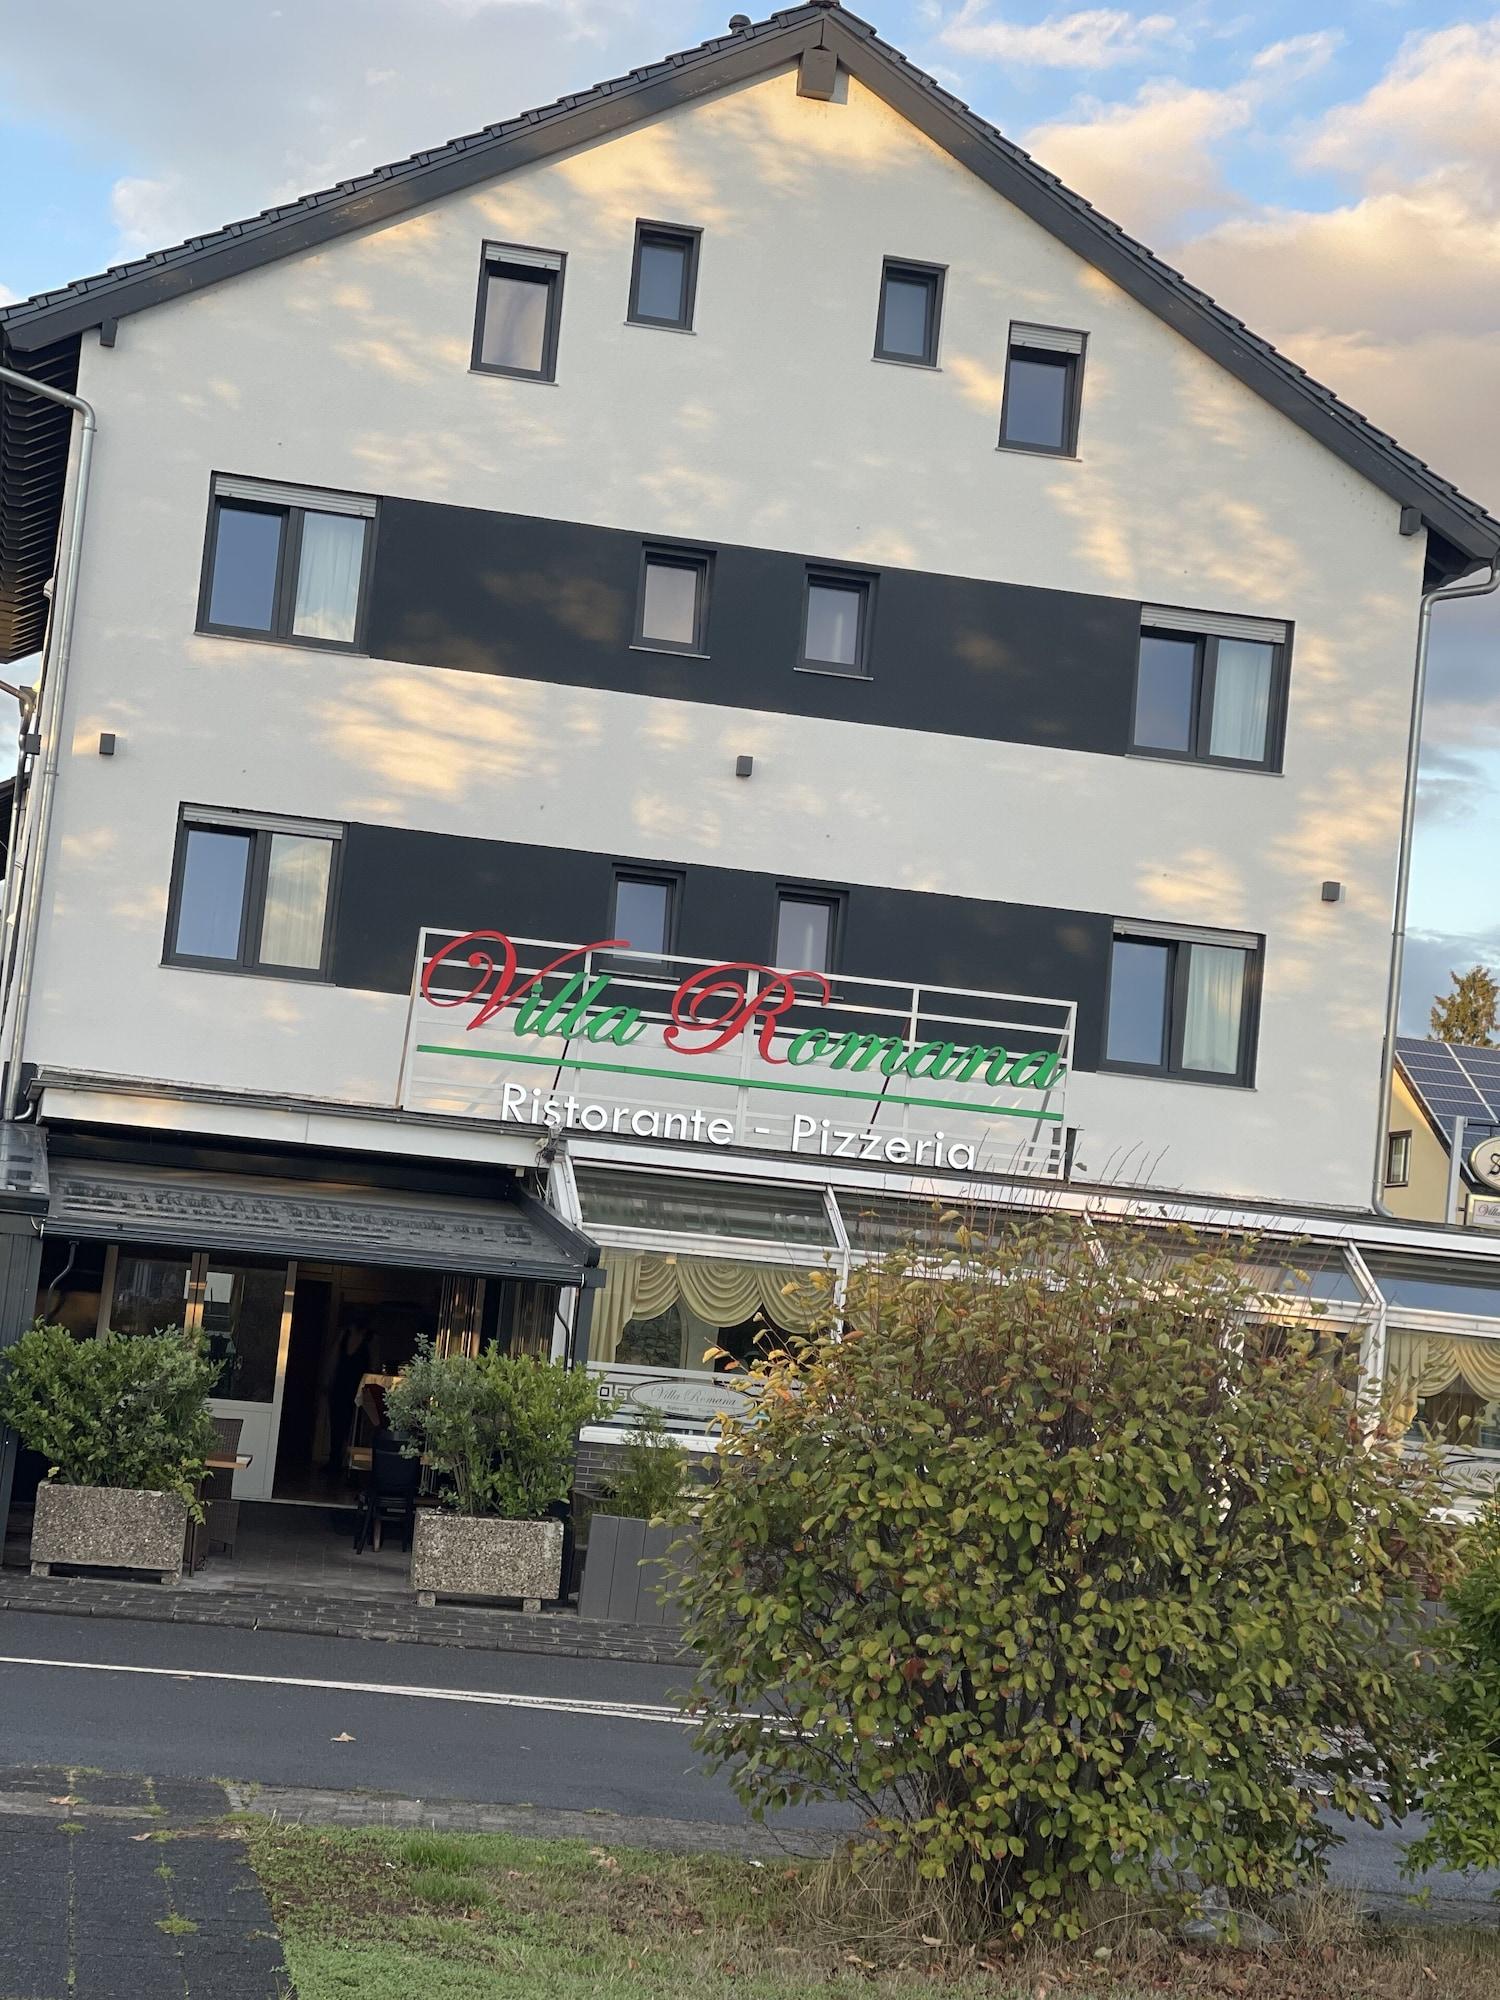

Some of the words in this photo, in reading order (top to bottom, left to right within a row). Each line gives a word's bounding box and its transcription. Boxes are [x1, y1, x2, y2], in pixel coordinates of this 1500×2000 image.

[421, 930, 647, 1046] Villa
[664, 962, 1067, 1090] Romana
[502, 1083, 734, 1146] Ristorante
[791, 1114, 976, 1171] Pizzeria
